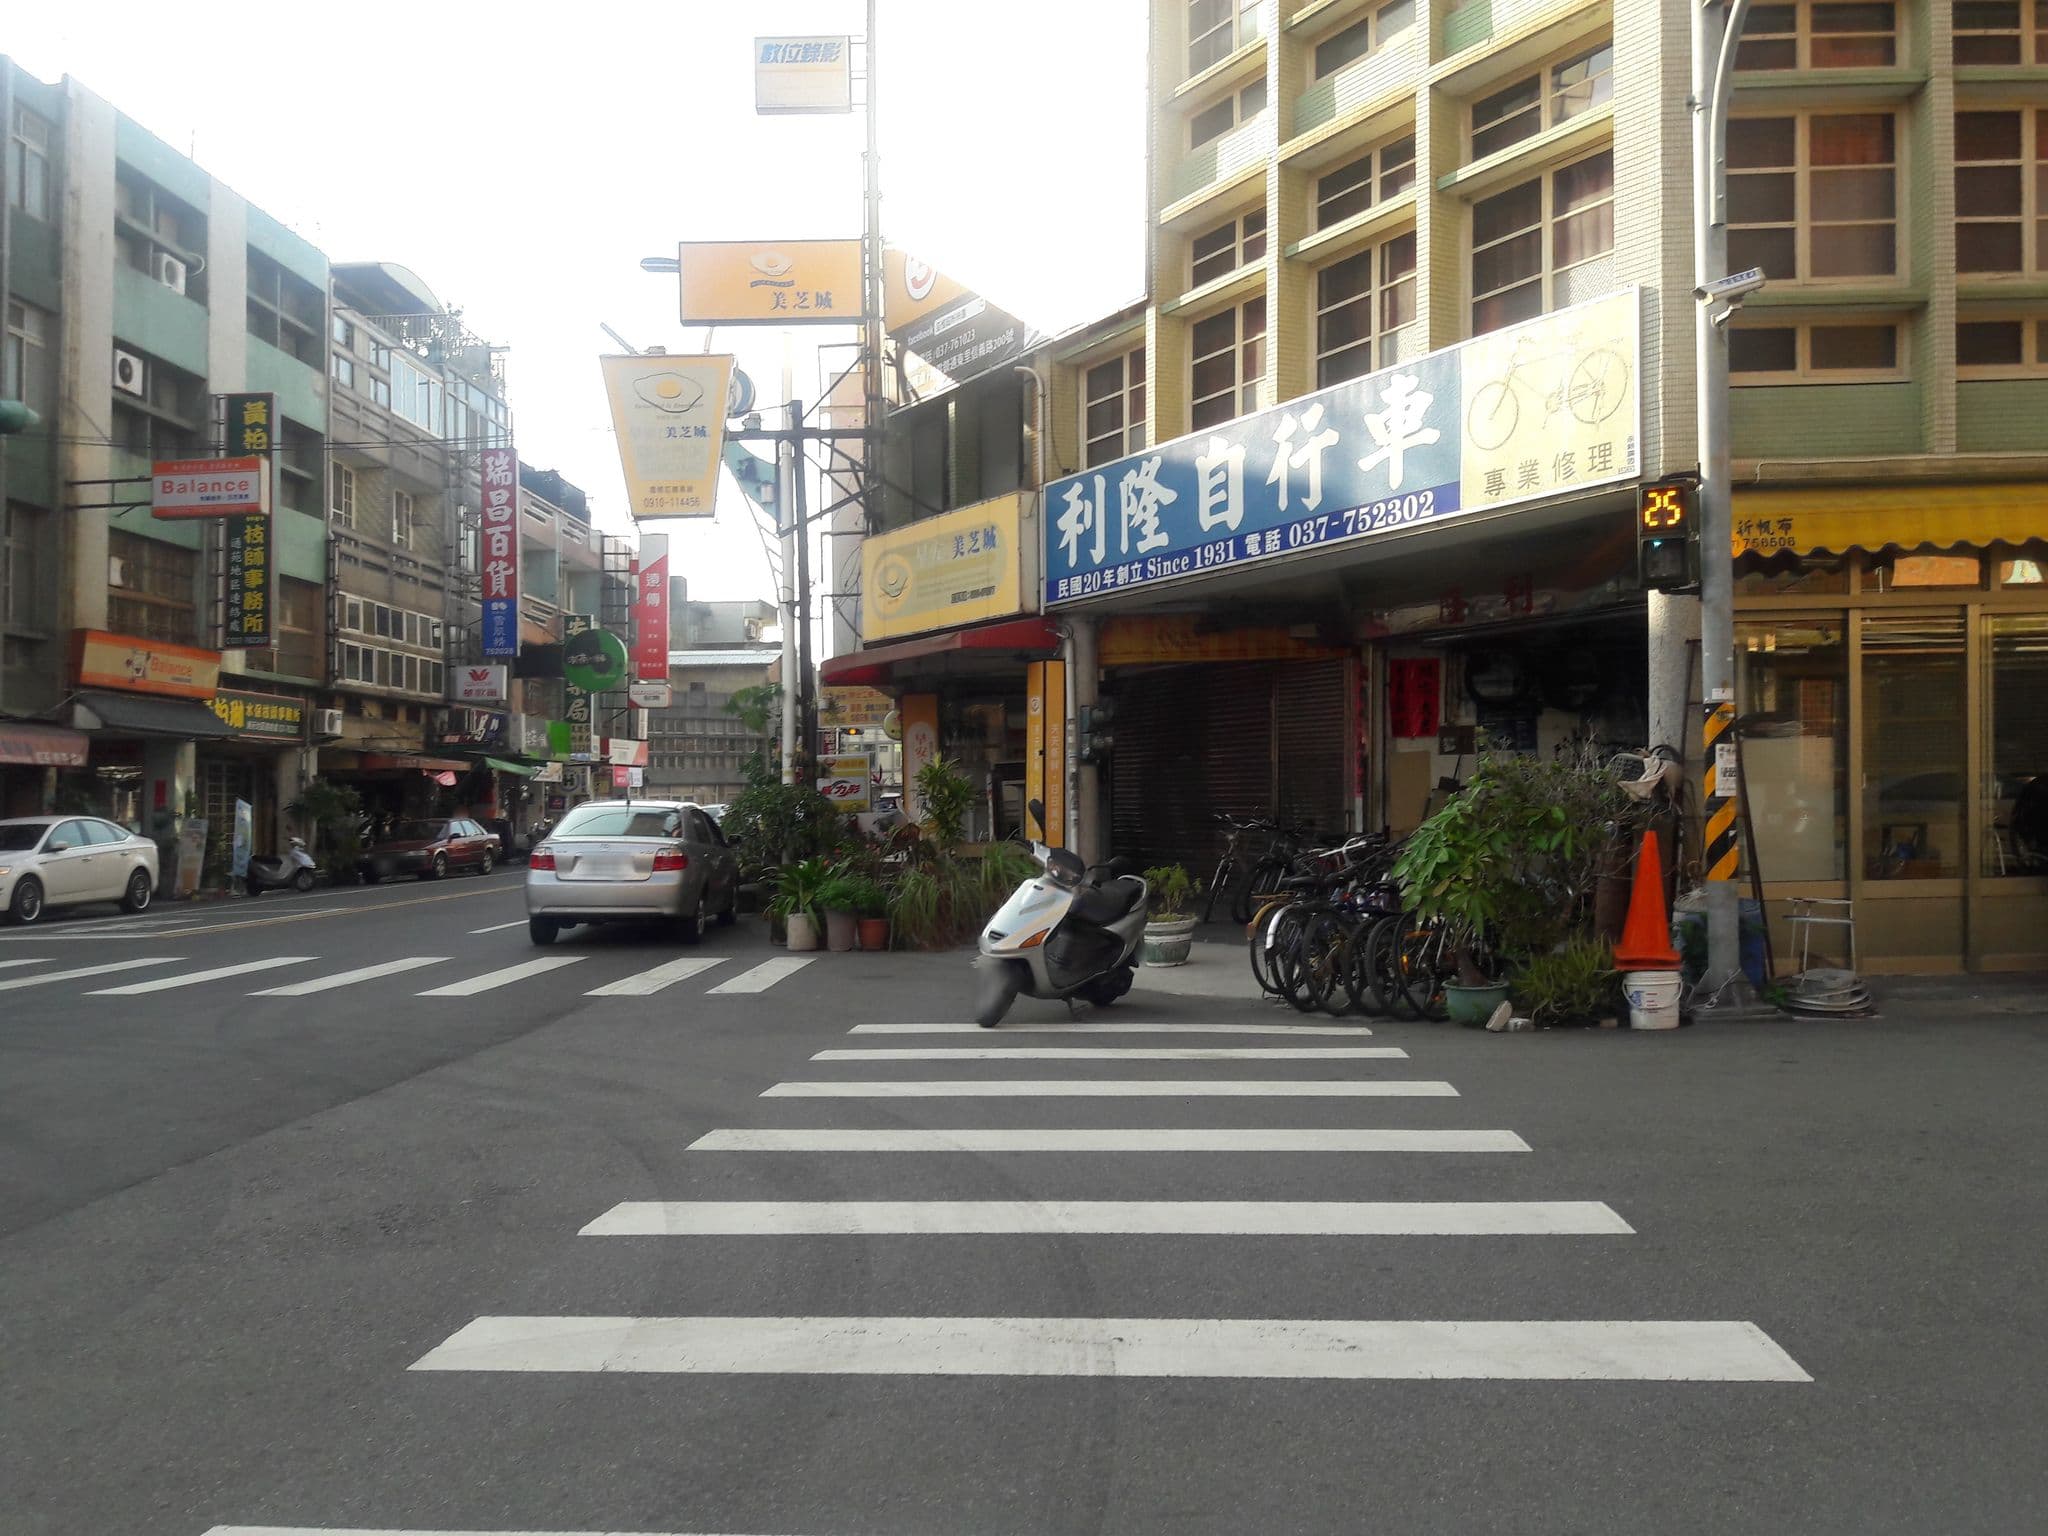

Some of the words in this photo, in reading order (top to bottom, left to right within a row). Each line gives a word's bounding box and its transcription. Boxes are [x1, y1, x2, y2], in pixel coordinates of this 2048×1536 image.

[770, 291, 833, 311] 美芝城
[665, 425, 711, 441] 美芝城
[161, 479, 250, 495] Balance
[1056, 374, 1442, 570] 利隆自行車
[1483, 441, 1613, 498] 專業修理
[485, 451, 515, 599] 瑞昌百貨
[1645, 490, 1681, 526] 25
[952, 526, 997, 560] 美芝城
[1057, 560, 1143, 599] 民國20年創立
[1147, 551, 1191, 581] Since
[1193, 538, 1237, 569] 1931
[1245, 529, 1282, 557] 電話
[1289, 494, 1436, 549] 037-752302
